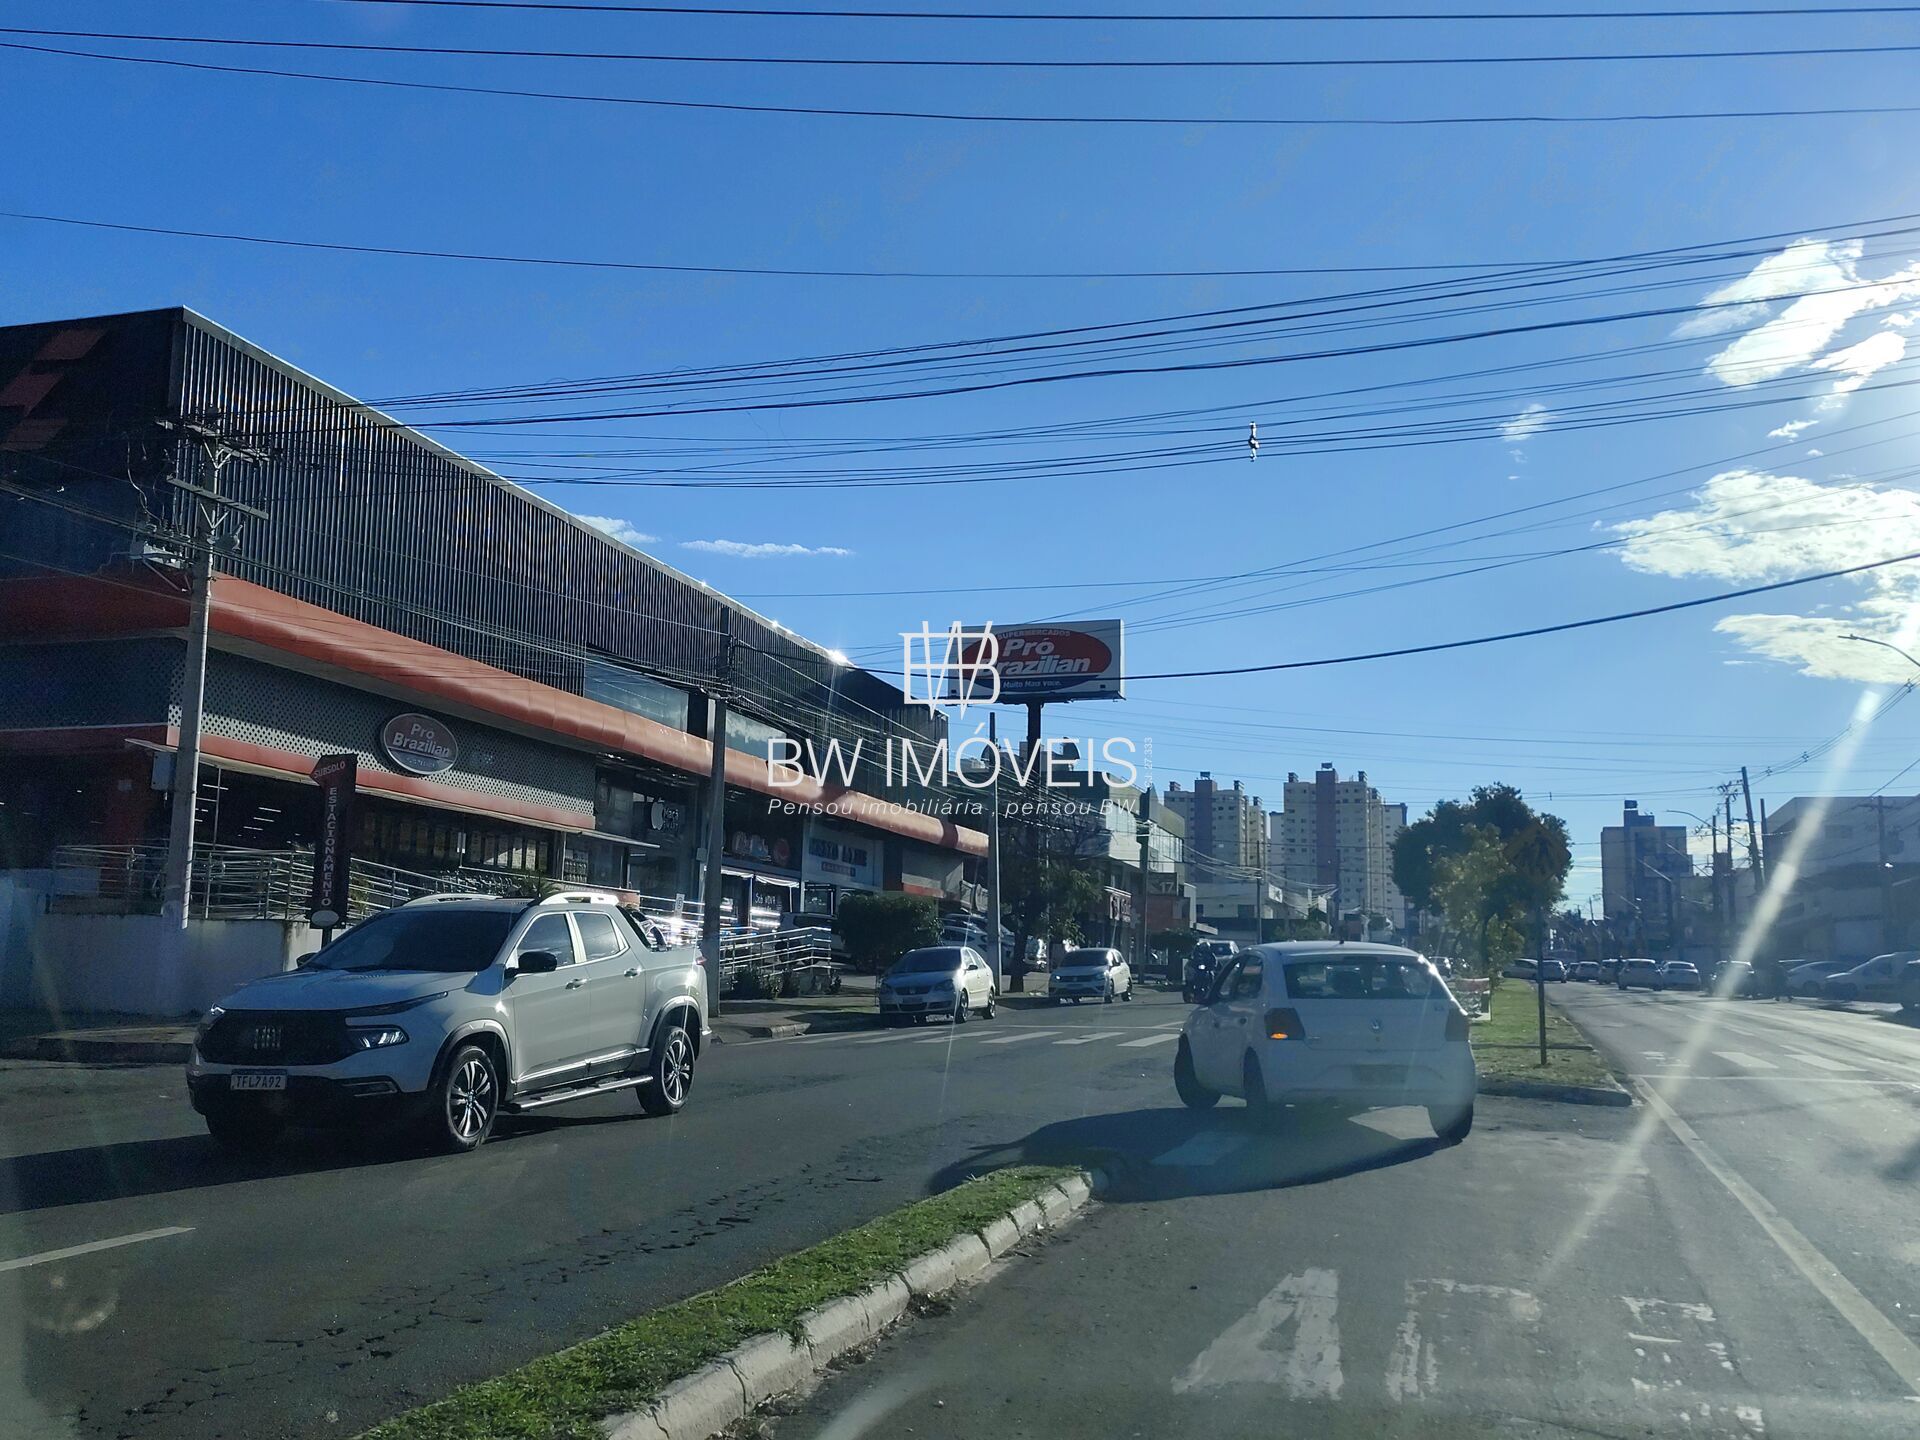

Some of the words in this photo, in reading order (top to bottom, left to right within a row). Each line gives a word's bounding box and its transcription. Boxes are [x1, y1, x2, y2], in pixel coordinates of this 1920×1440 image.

[1002, 637, 1055, 657] Pró
[393, 732, 450, 757] Brazilian
[321, 787, 337, 906] ESTACIONAMENTO
